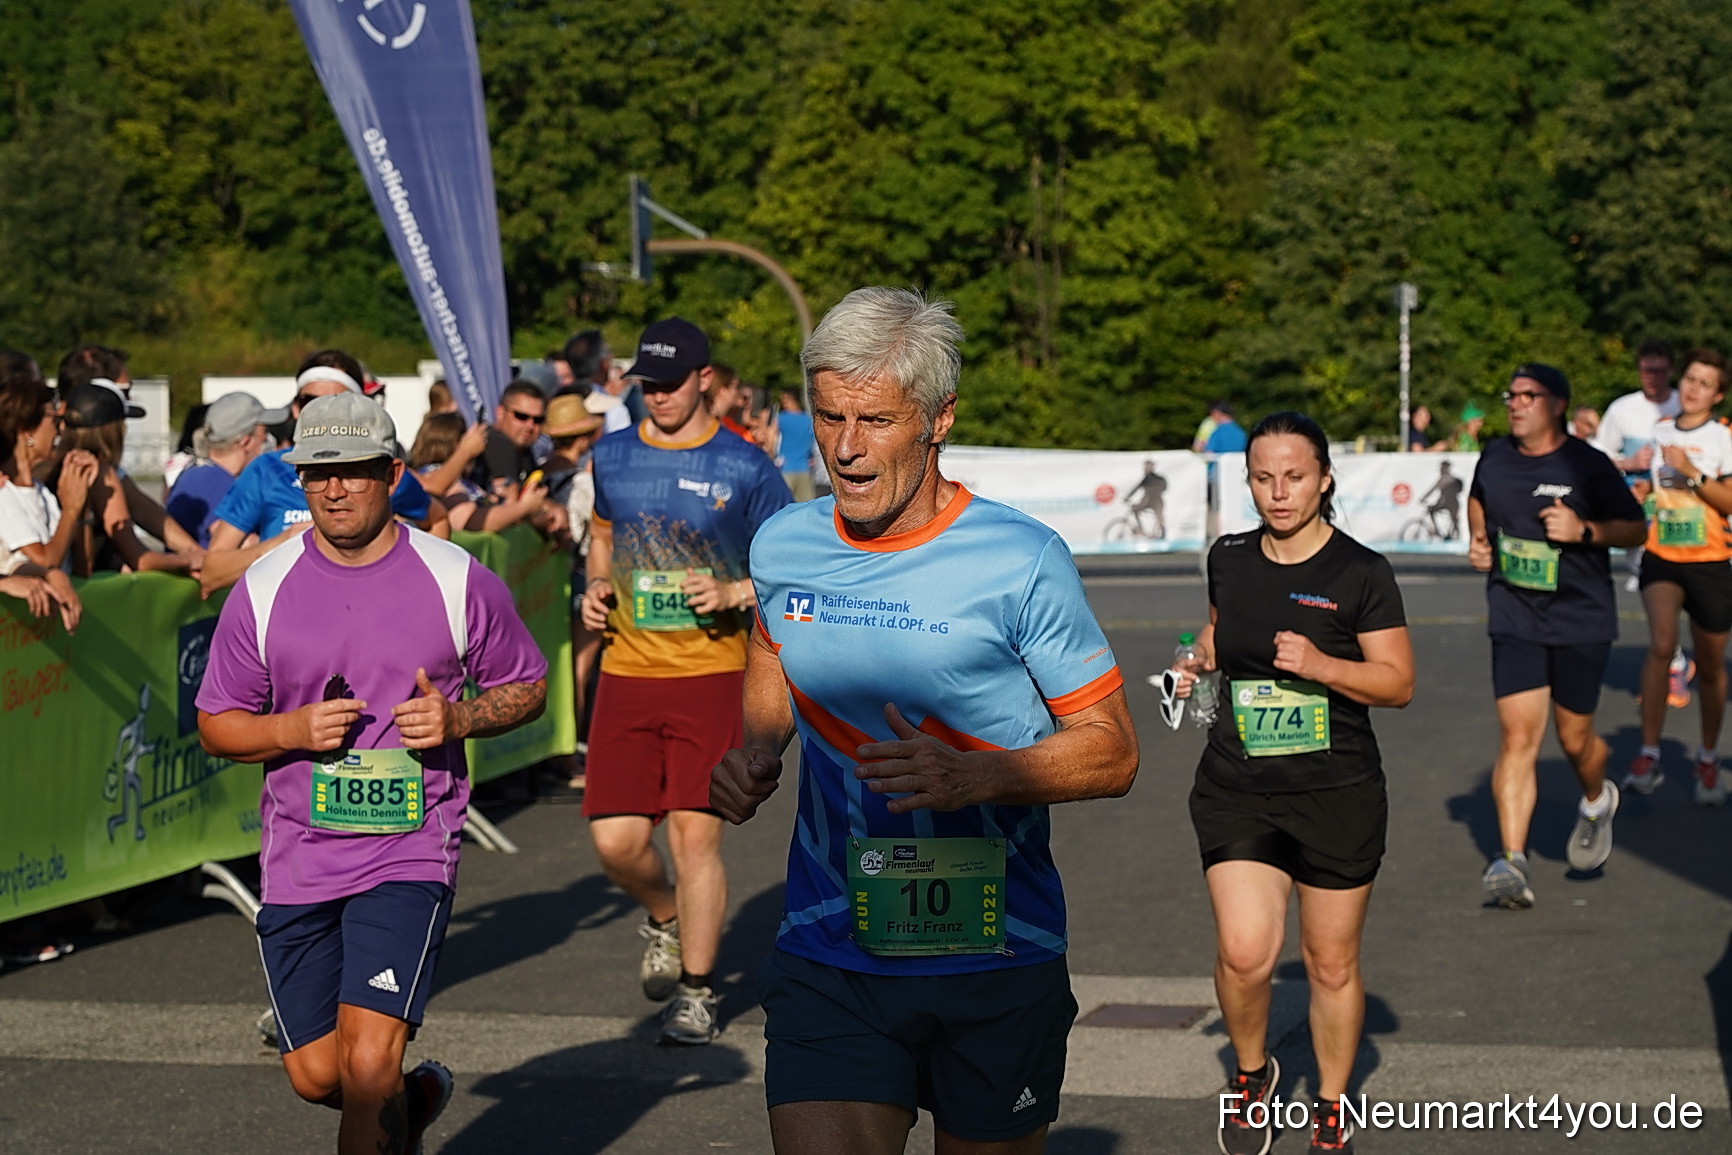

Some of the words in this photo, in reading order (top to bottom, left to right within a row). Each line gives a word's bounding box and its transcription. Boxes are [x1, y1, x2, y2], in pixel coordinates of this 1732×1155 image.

[302, 425, 328, 438] KEEP
[330, 425, 370, 437] GOING
[821, 594, 910, 613] Raiffeisenbank
[819, 611, 877, 627] Neumarkt
[929, 622, 949, 634] eG
[1253, 707, 1304, 731] 774
[1249, 733, 1276, 741] Ulrich
[1278, 732, 1310, 740] Marion
[316, 783, 327, 812] RUN
[329, 777, 405, 805] 1885
[407, 781, 418, 820] 2022
[326, 804, 368, 817] Holstein
[370, 808, 407, 818] Dennis
[886, 859, 936, 870] Firmenlauf
[901, 878, 951, 917] 10
[856, 891, 869, 931] RUN
[982, 883, 997, 937] 2022
[887, 920, 920, 934] Fritz
[923, 920, 964, 934] Franz
[368, 978, 400, 994] adidas
[1012, 1096, 1038, 1113] adidas
